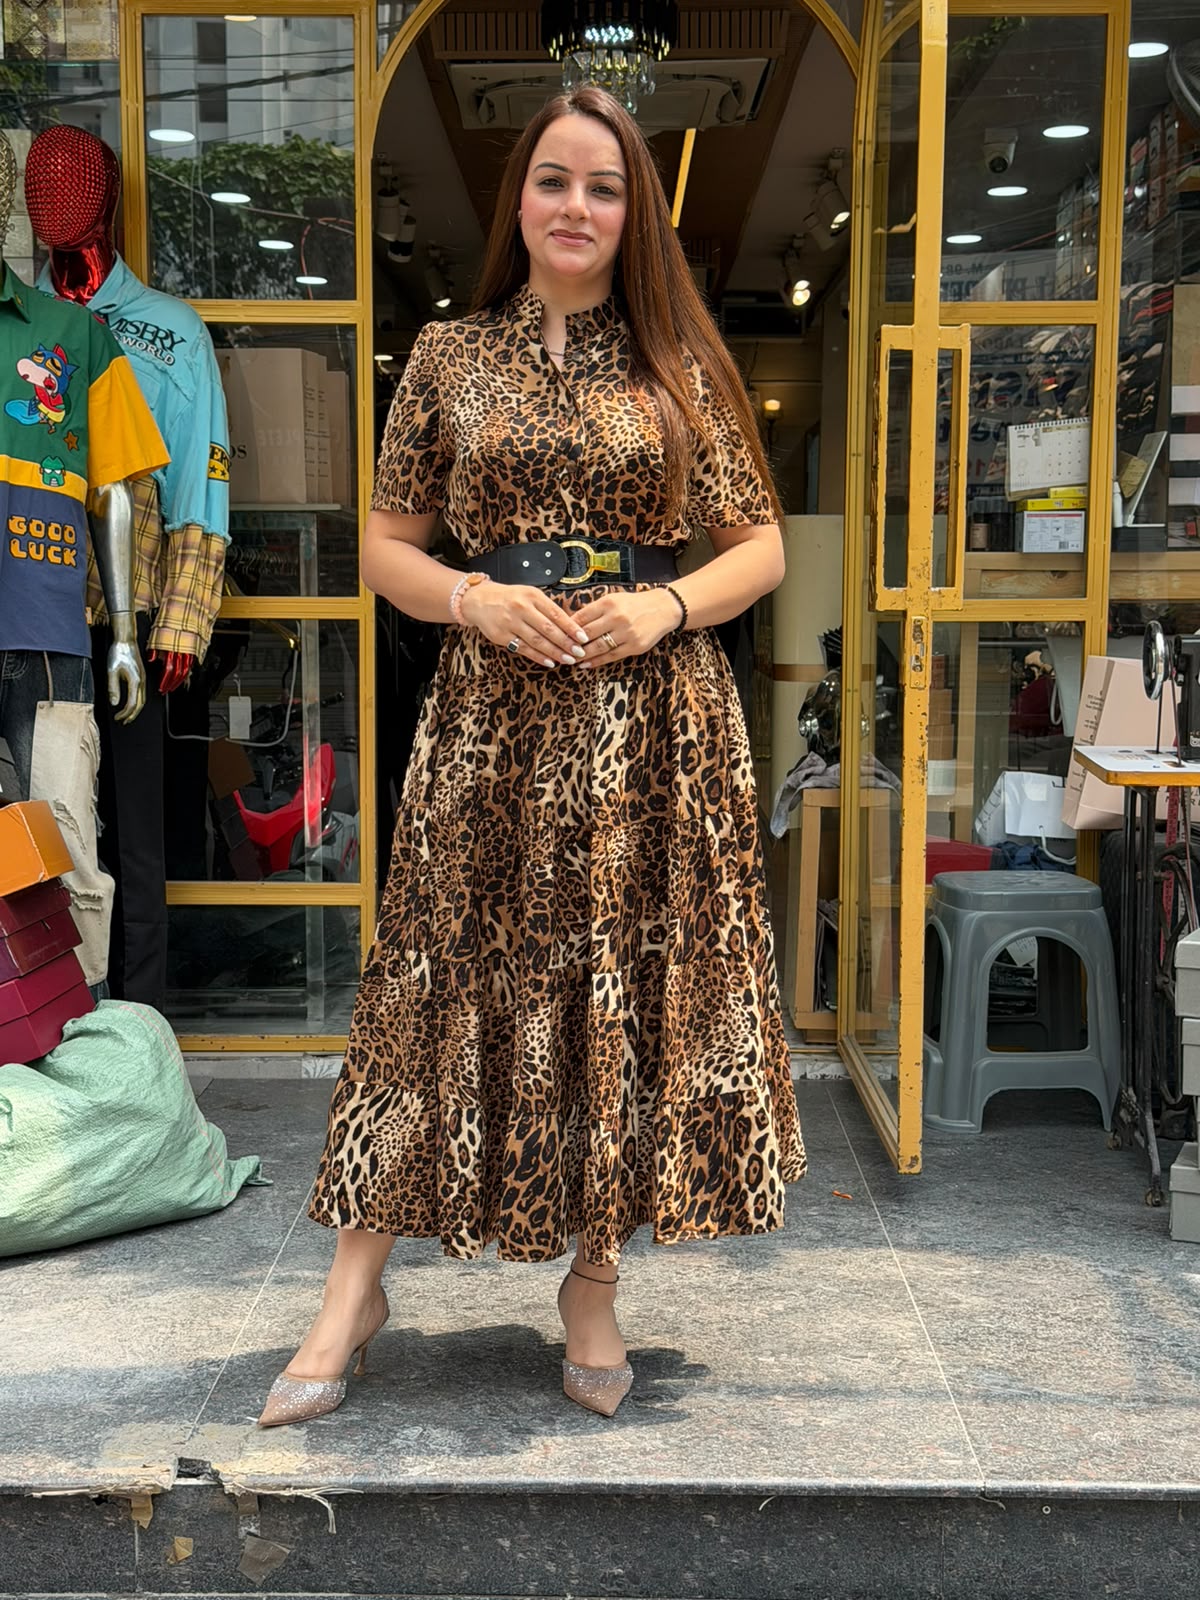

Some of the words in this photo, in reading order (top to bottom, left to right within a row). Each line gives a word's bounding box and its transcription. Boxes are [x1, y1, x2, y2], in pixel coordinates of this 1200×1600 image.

[121, 335, 176, 367] WORLD
[8, 514, 77, 545] GOOD
[9, 537, 77, 568] LUCK
